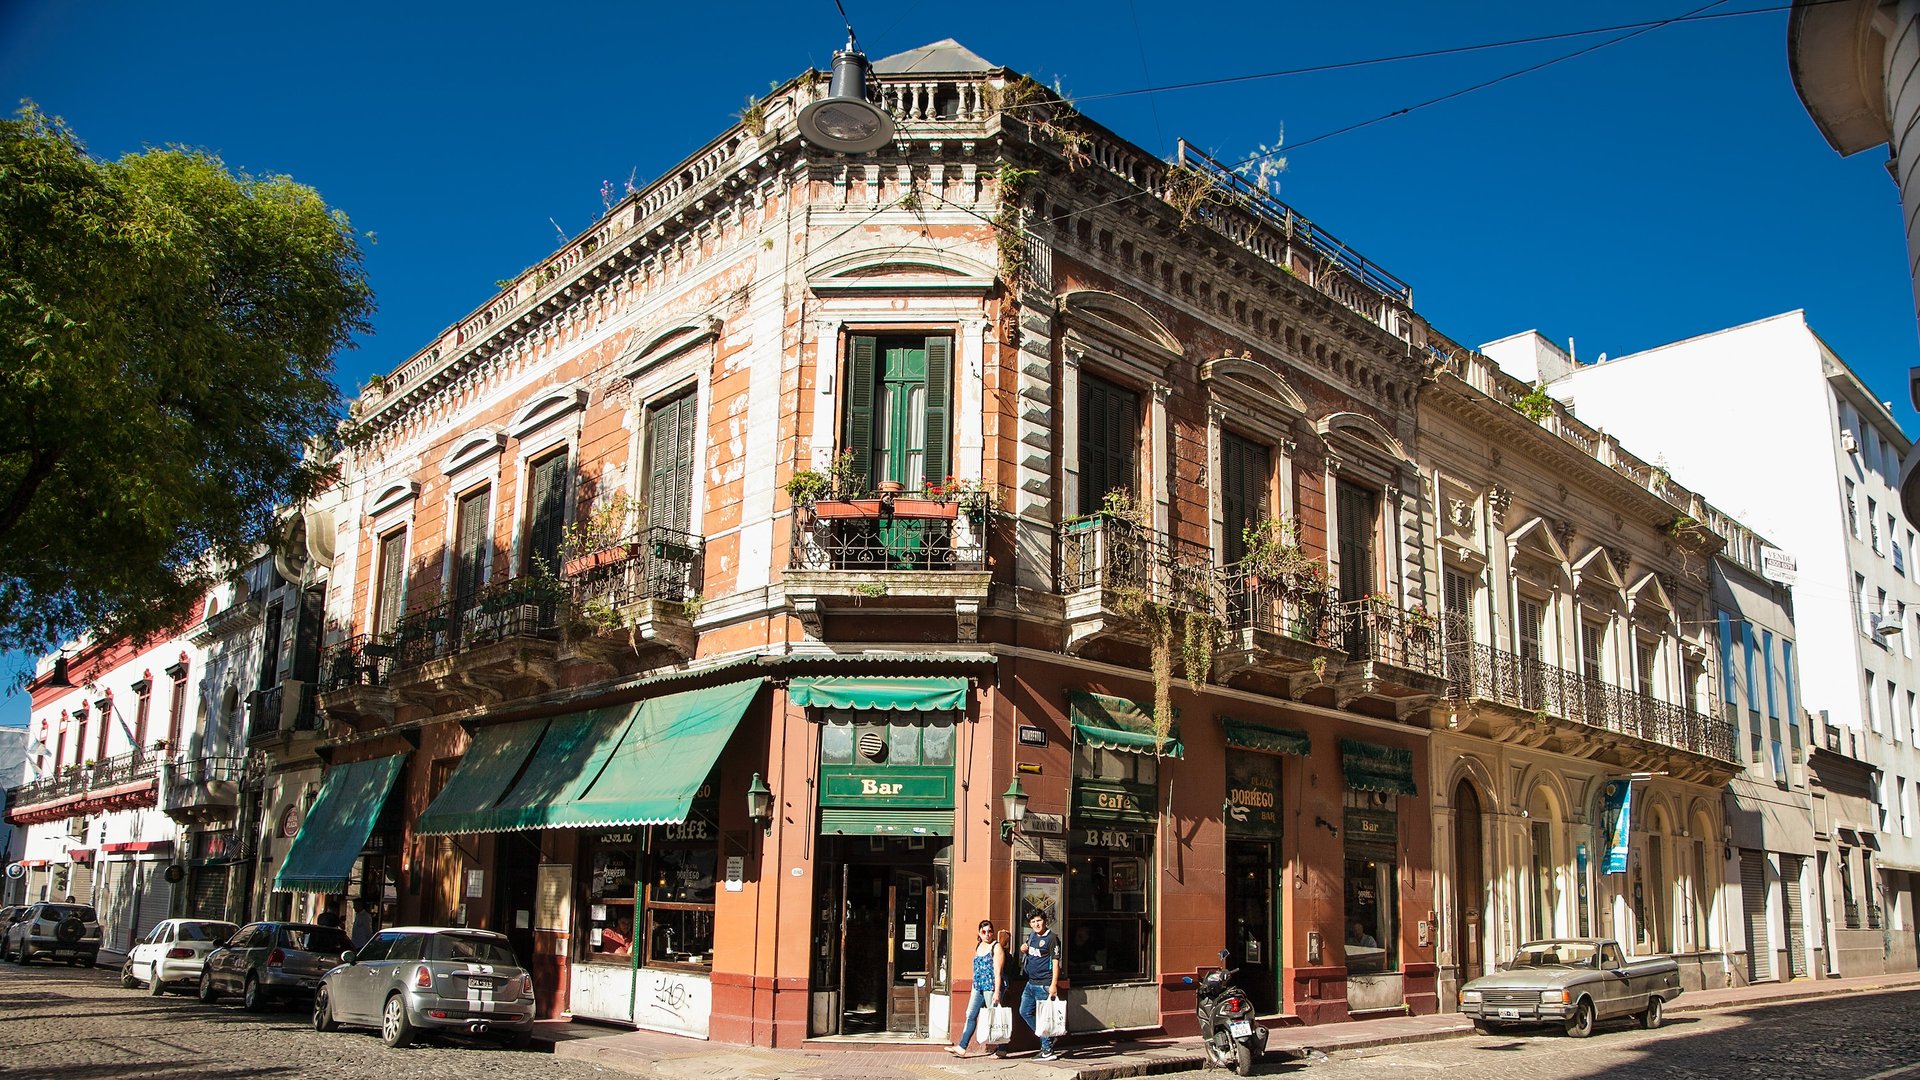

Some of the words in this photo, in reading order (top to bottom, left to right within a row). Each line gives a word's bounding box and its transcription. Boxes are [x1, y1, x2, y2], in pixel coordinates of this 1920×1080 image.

[1767, 551, 1791, 562] VENDE
[861, 779, 903, 795] Bar
[1098, 793, 1131, 809] Café
[1261, 811, 1276, 823] BAR
[1362, 820, 1379, 832] Bar
[1085, 829, 1130, 848] BAR
